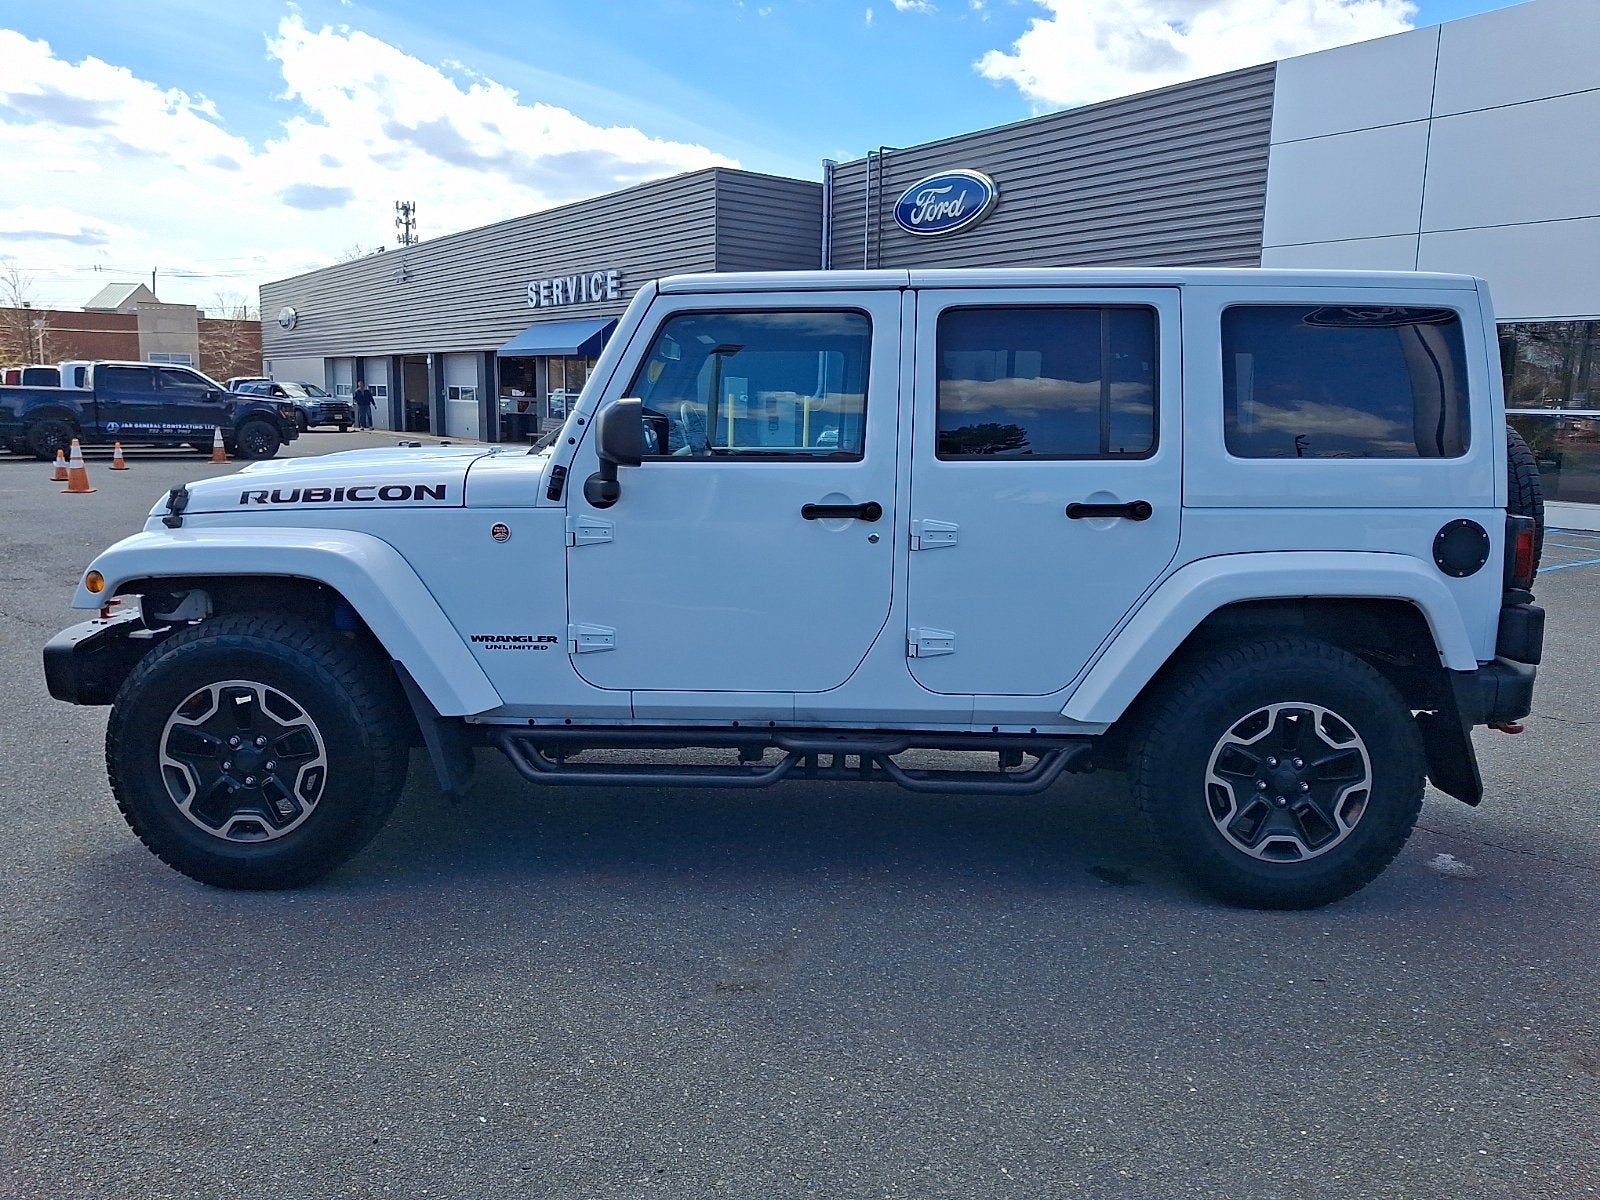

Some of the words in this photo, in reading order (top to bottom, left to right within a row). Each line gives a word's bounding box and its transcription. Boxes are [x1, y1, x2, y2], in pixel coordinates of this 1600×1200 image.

[911, 185, 967, 225] Ford
[527, 270, 620, 308] SERVICE
[239, 484, 447, 505] RUBICON
[470, 634, 558, 644] WRANGLER
